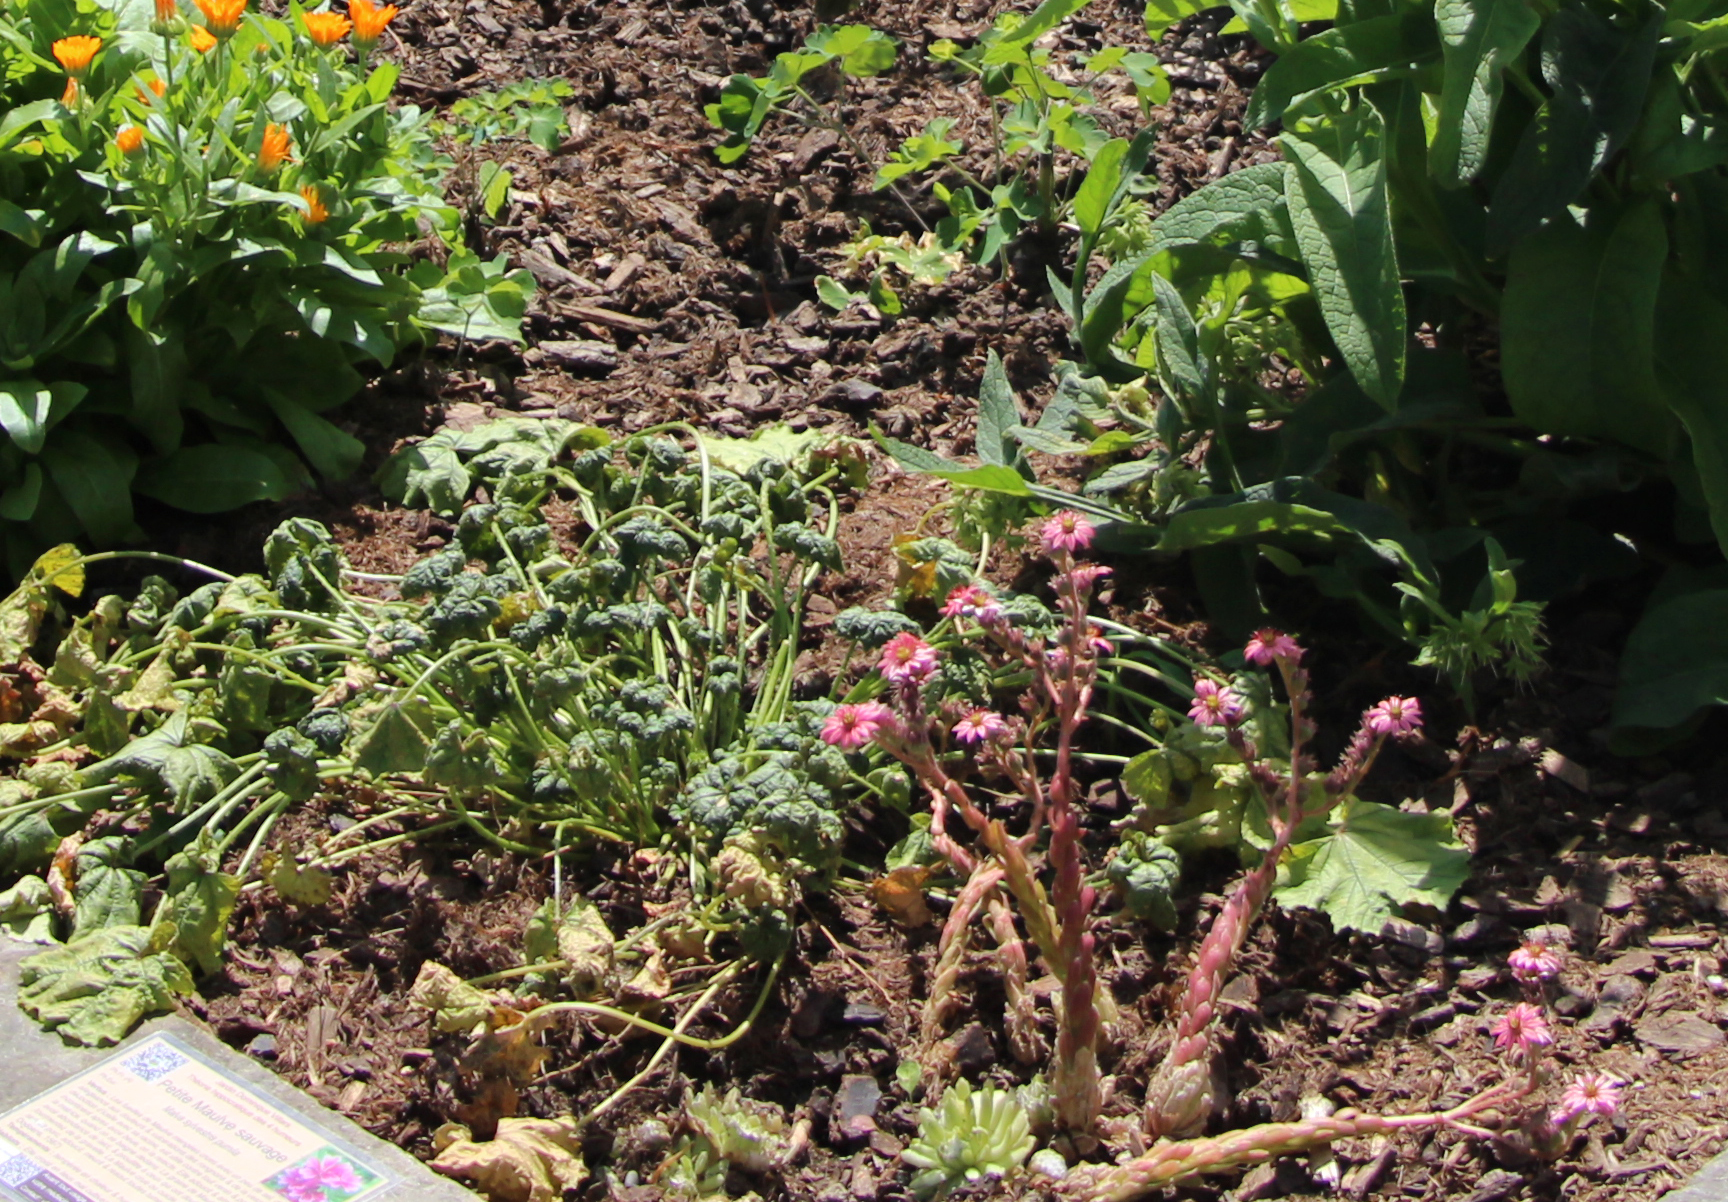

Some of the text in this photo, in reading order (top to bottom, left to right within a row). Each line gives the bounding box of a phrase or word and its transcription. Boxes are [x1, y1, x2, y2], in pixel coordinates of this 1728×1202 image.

[154, 1078, 291, 1165] Petite Maulve sauvage
